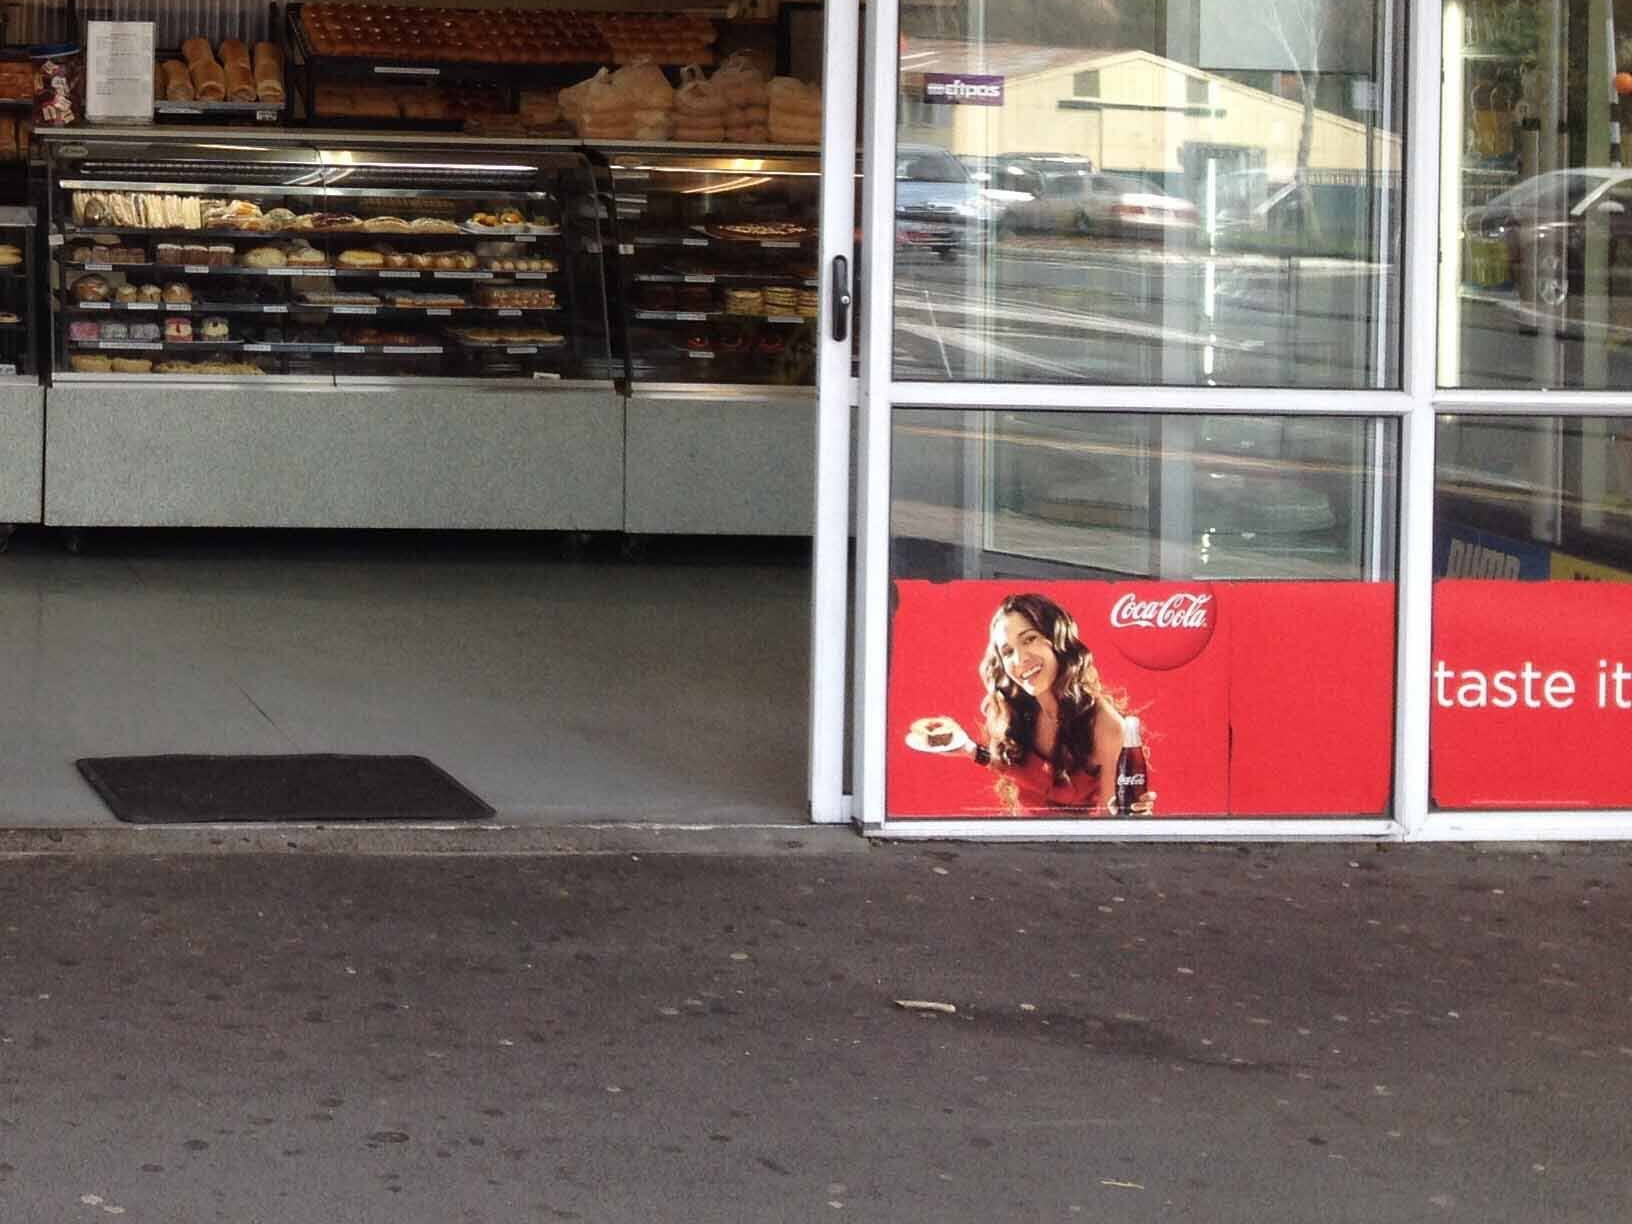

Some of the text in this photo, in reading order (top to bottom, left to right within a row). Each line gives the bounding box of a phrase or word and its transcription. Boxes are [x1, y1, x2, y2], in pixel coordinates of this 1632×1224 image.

[1110, 592, 1212, 628] Coca-Cola
[1433, 658, 1632, 708] taste it
